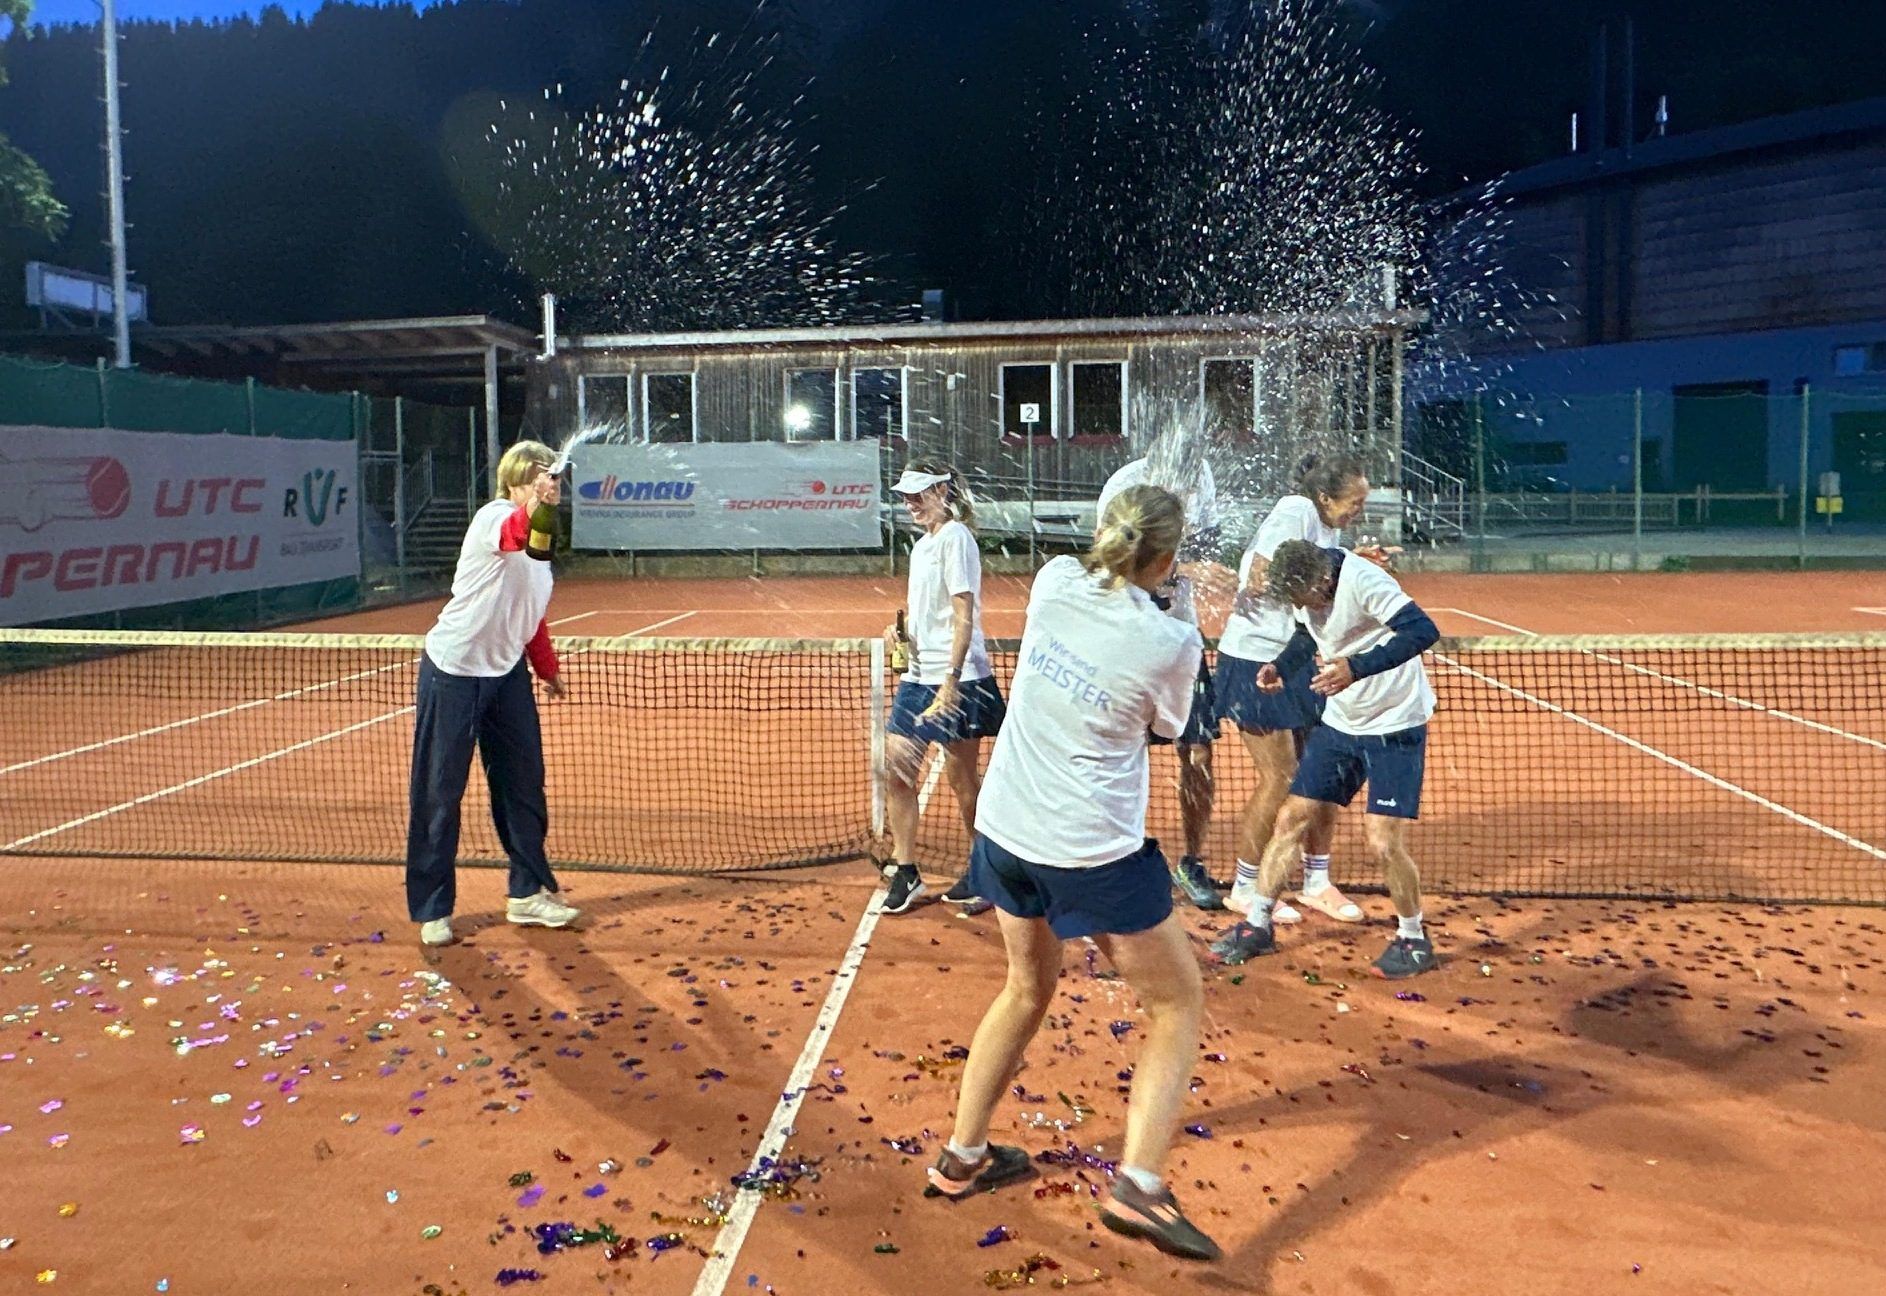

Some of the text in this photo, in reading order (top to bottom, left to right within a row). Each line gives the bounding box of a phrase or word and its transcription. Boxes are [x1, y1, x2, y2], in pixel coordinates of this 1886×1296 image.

[1026, 406, 1035, 420] 2
[154, 478, 266, 518] UTC
[831, 483, 874, 495] UTC
[0, 534, 262, 599] PERNAU
[1027, 646, 1112, 712] MEISTER
